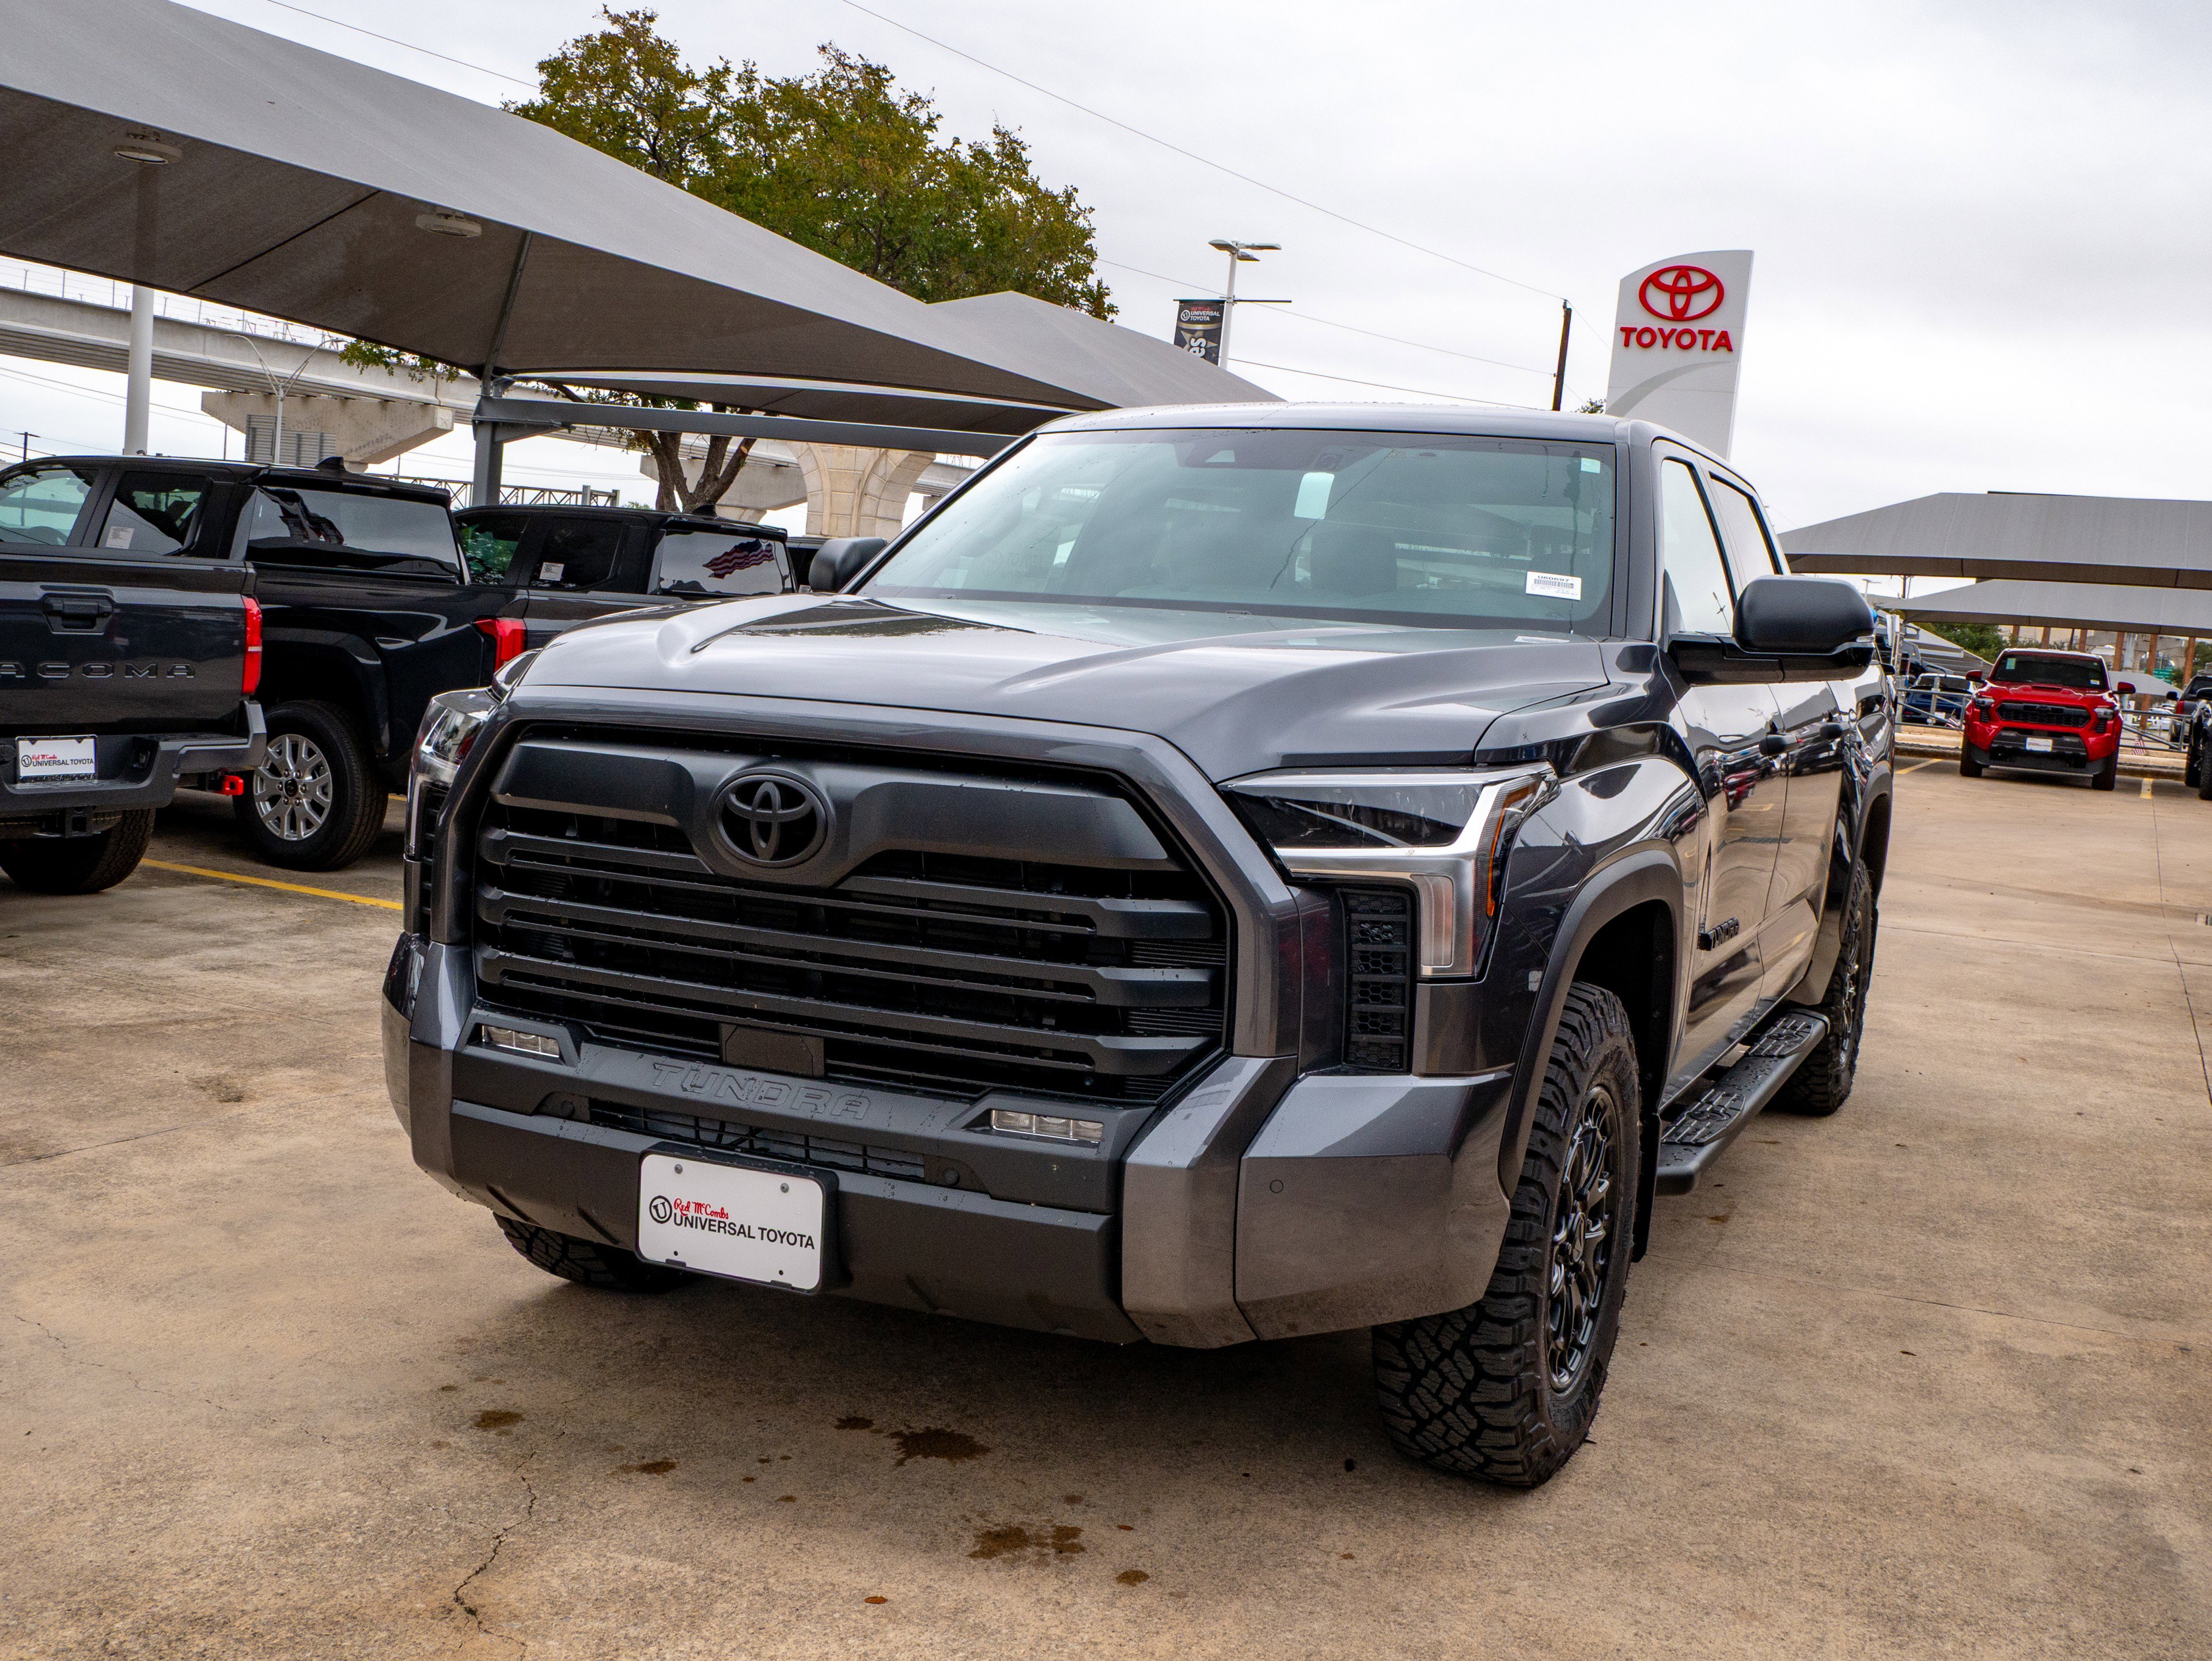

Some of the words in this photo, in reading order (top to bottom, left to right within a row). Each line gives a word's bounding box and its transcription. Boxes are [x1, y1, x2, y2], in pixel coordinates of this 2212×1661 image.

[1620, 327, 1733, 351] TOYOTA
[653, 1063, 871, 1119] TUNDRA
[674, 1198, 691, 1217] Red
[692, 1201, 729, 1219] McCombs
[673, 1213, 756, 1239] UNIVERSAL
[757, 1227, 815, 1250] TOYOTA
